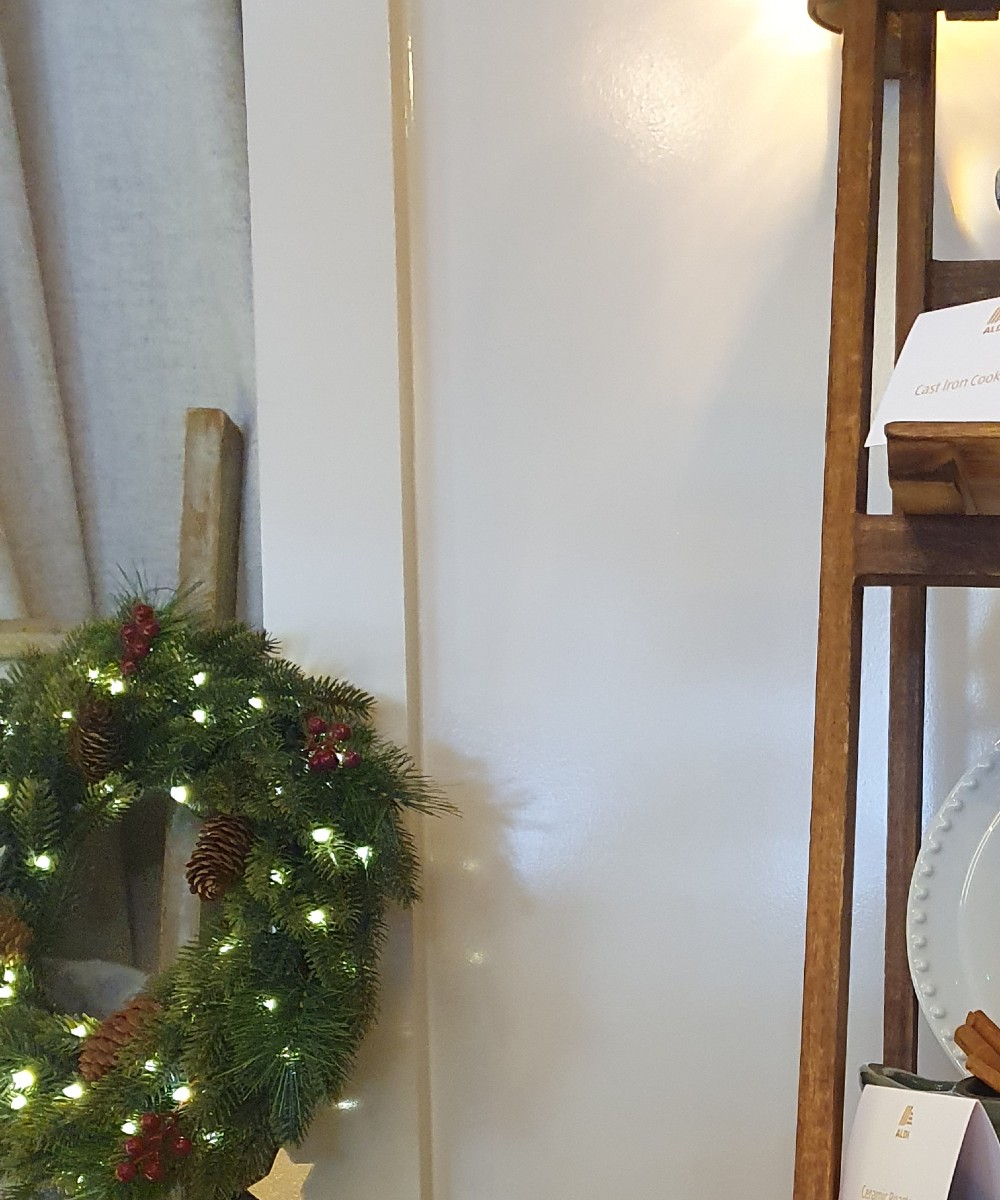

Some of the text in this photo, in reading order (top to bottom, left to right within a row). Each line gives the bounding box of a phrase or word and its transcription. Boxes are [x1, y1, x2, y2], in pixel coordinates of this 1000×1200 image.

[914, 383, 941, 396] Cast
[942, 379, 969, 391] Iron
[895, 1129, 909, 1139] ALDI
